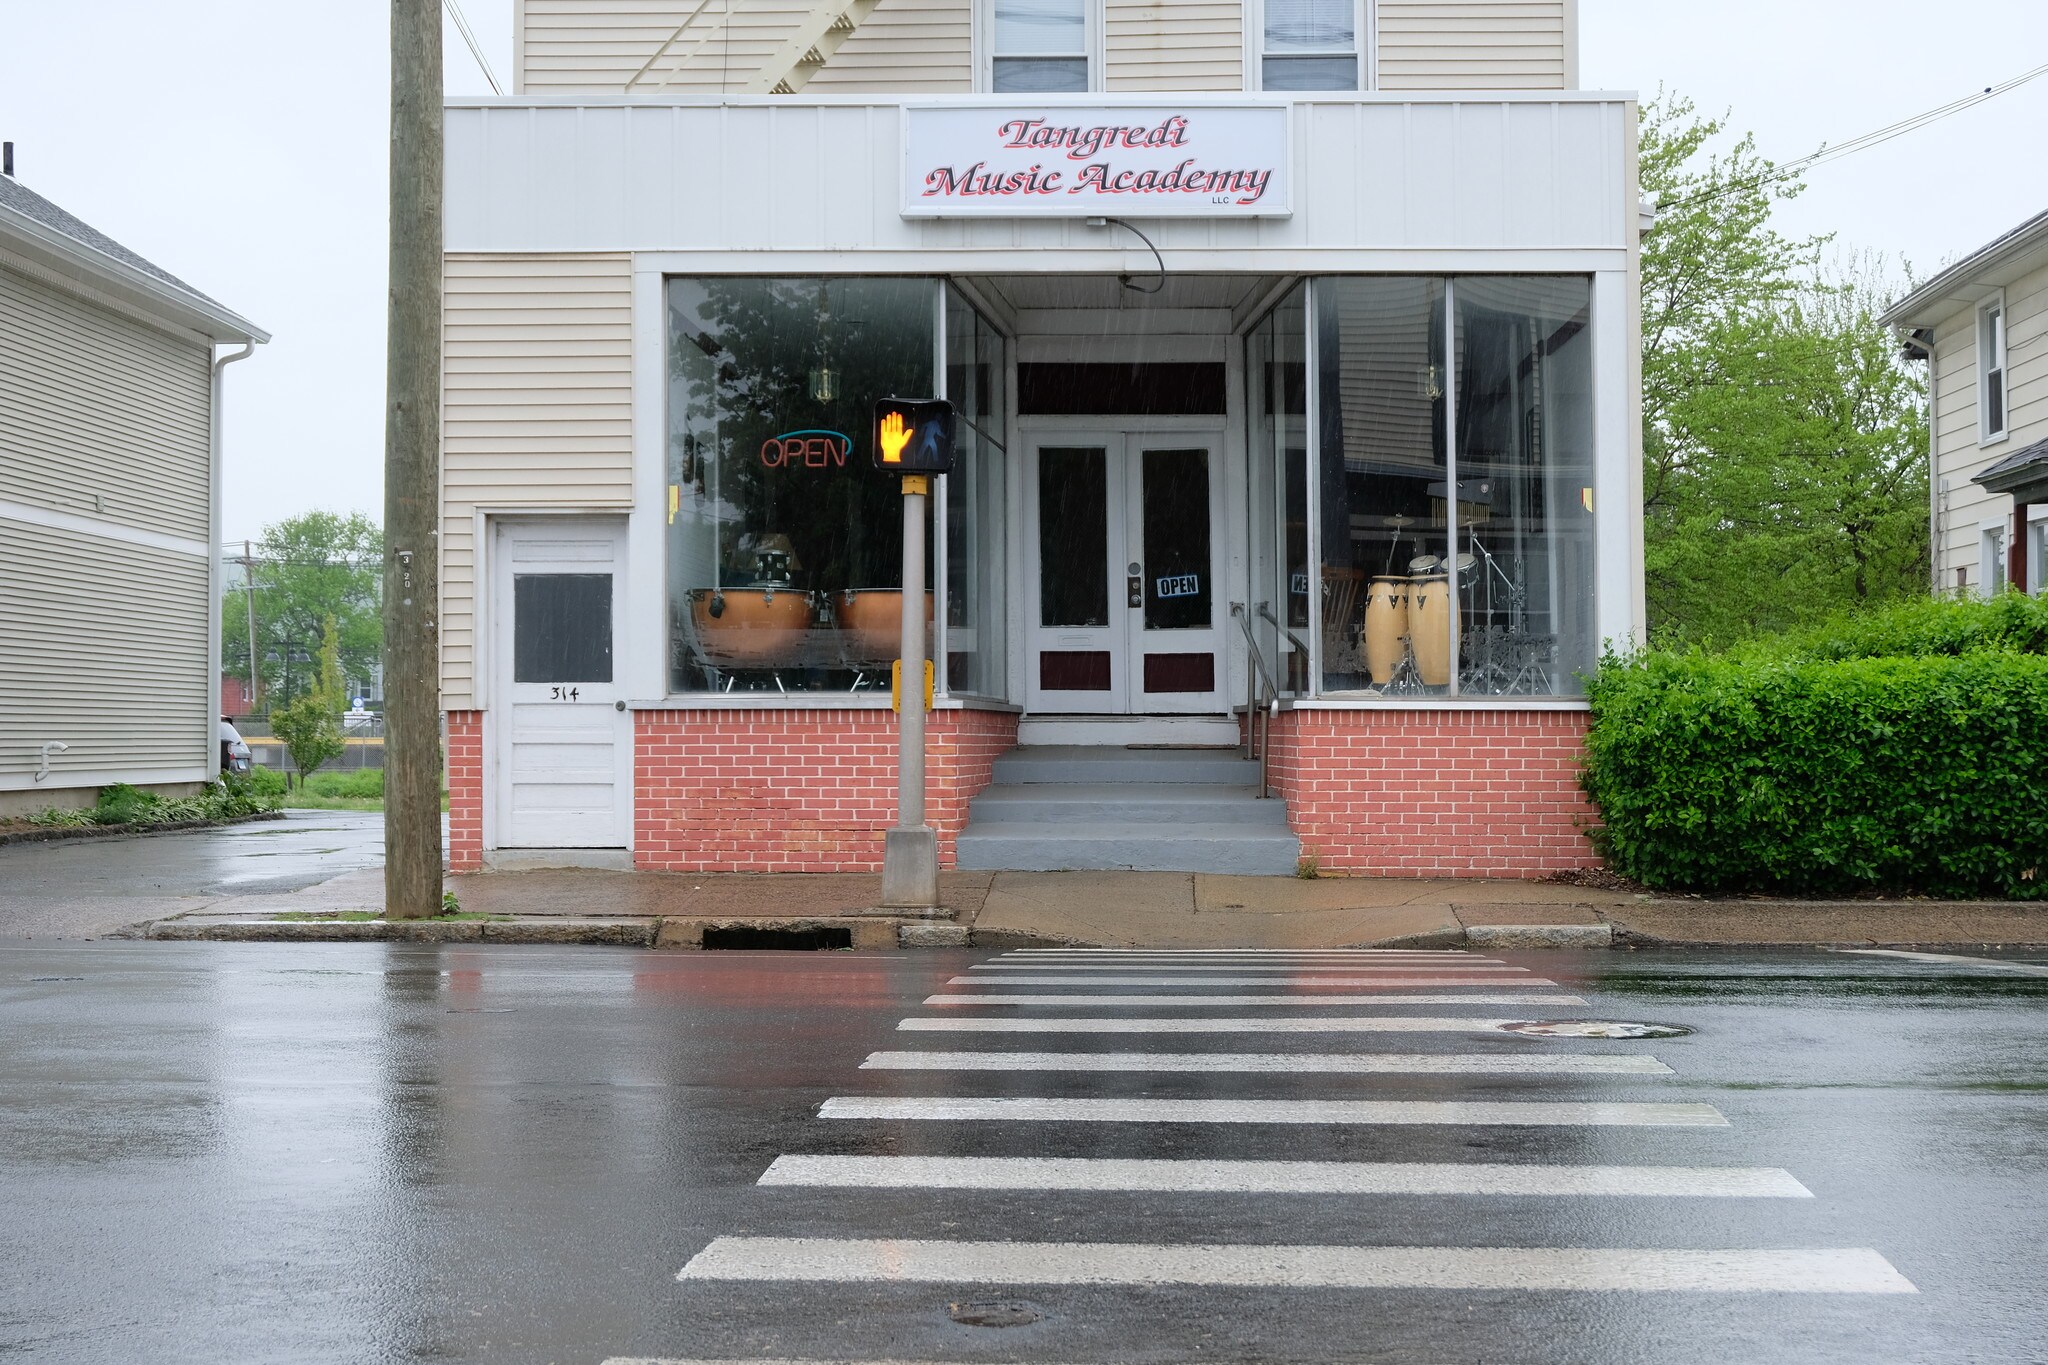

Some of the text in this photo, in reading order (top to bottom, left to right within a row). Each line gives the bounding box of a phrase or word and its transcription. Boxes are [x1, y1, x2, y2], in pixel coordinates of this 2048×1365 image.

[998, 115, 1191, 160] Tangredi
[921, 158, 1275, 205] Music Academy
[761, 438, 846, 467] OPEN
[403, 556, 409, 564] 3
[1160, 576, 1196, 595] OPEN
[550, 687, 579, 702] 314
